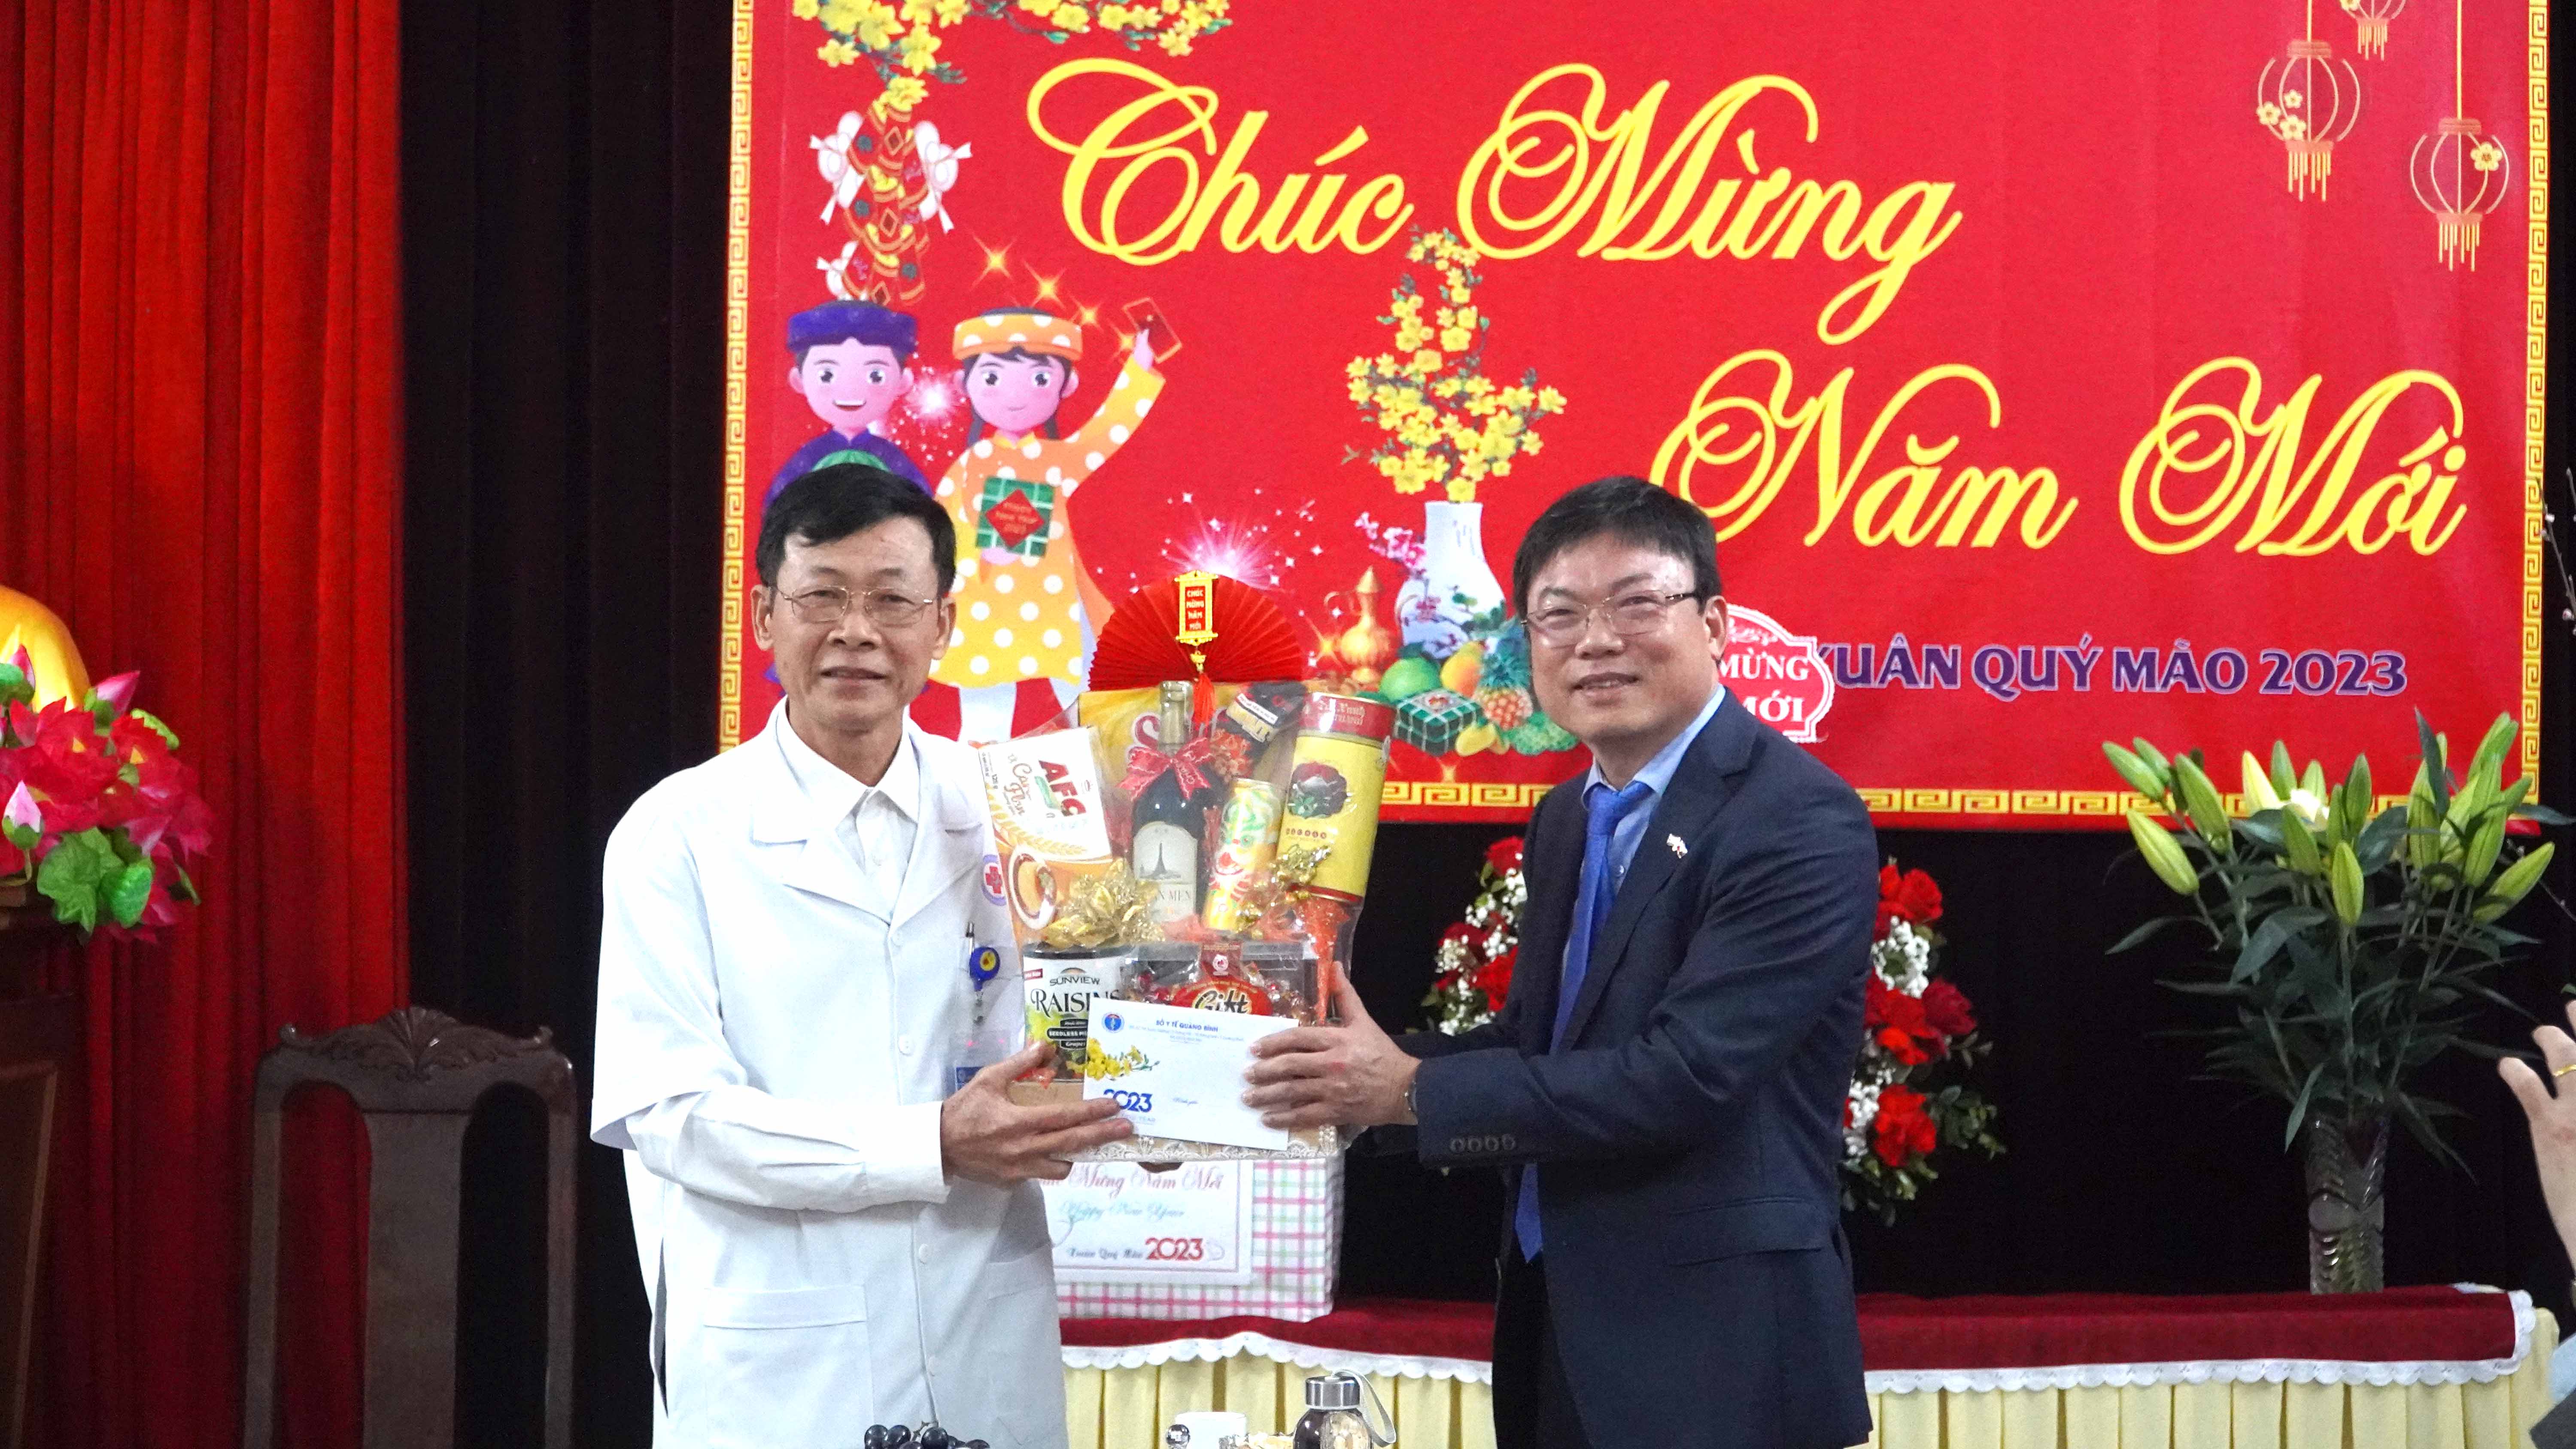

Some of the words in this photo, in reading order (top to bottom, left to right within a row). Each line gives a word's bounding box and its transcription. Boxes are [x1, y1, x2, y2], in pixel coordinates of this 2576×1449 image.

[1027, 58, 1414, 266] Chúc
[1457, 63, 1963, 346] Mừng
[1649, 350, 2079, 549] Năm
[2119, 357, 2467, 556] Mới
[1719, 647, 1809, 681] MỪNG
[1971, 633, 2104, 701] QUÝ
[2111, 639, 2248, 694] MÃO
[2259, 649, 2407, 697] 2023
[1038, 760, 1087, 817] AFC
[1049, 975, 1100, 987] SUNVIEW
[1031, 988, 1120, 1018] RAISI
[1194, 990, 1249, 1014] Gift
[1145, 1237, 1203, 1261] 2023
